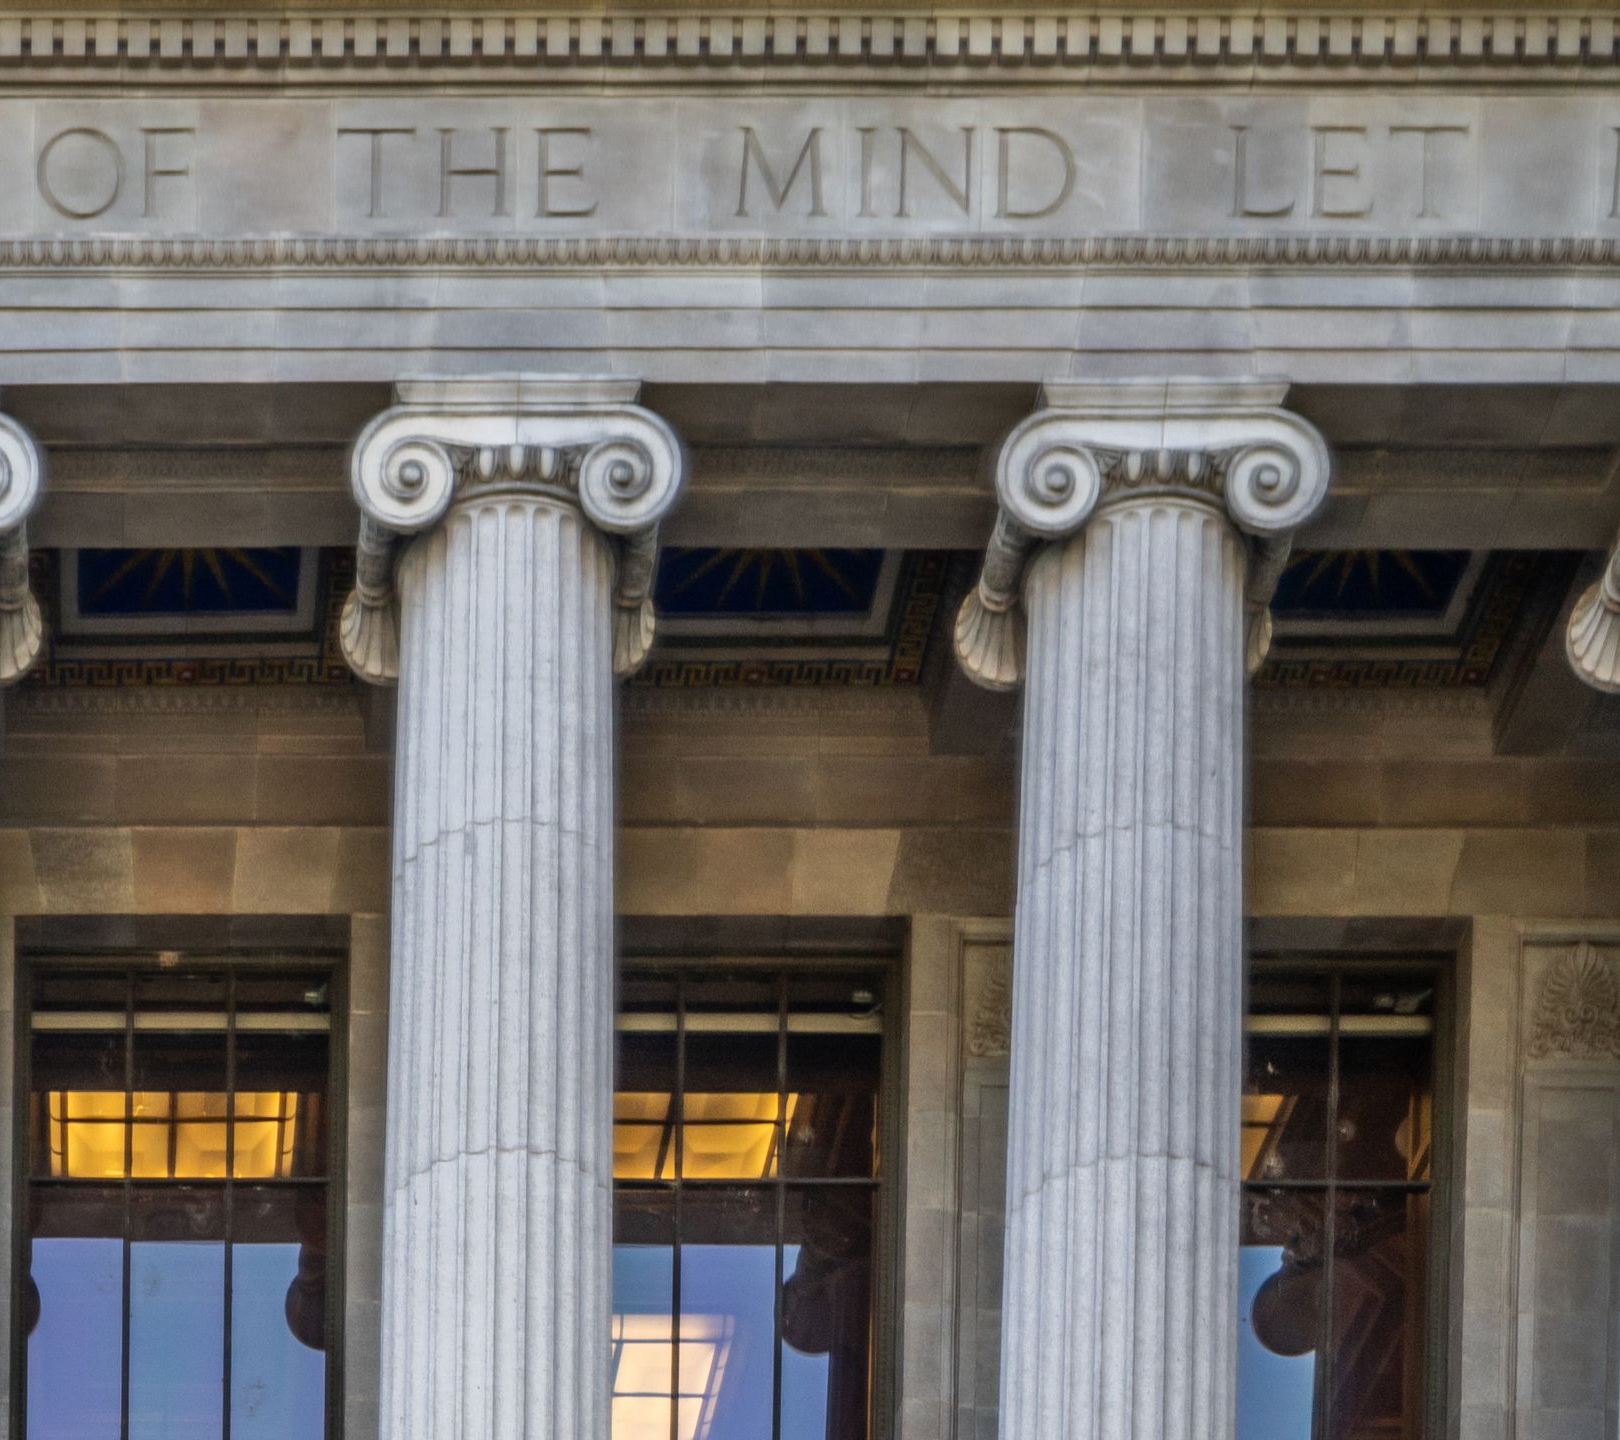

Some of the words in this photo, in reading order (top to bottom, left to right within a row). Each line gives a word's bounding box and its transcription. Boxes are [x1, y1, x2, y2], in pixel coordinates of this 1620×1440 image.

[35, 124, 199, 221] OF
[336, 125, 601, 220] THE
[732, 125, 1078, 221] MIND
[1224, 124, 1472, 219] LET
